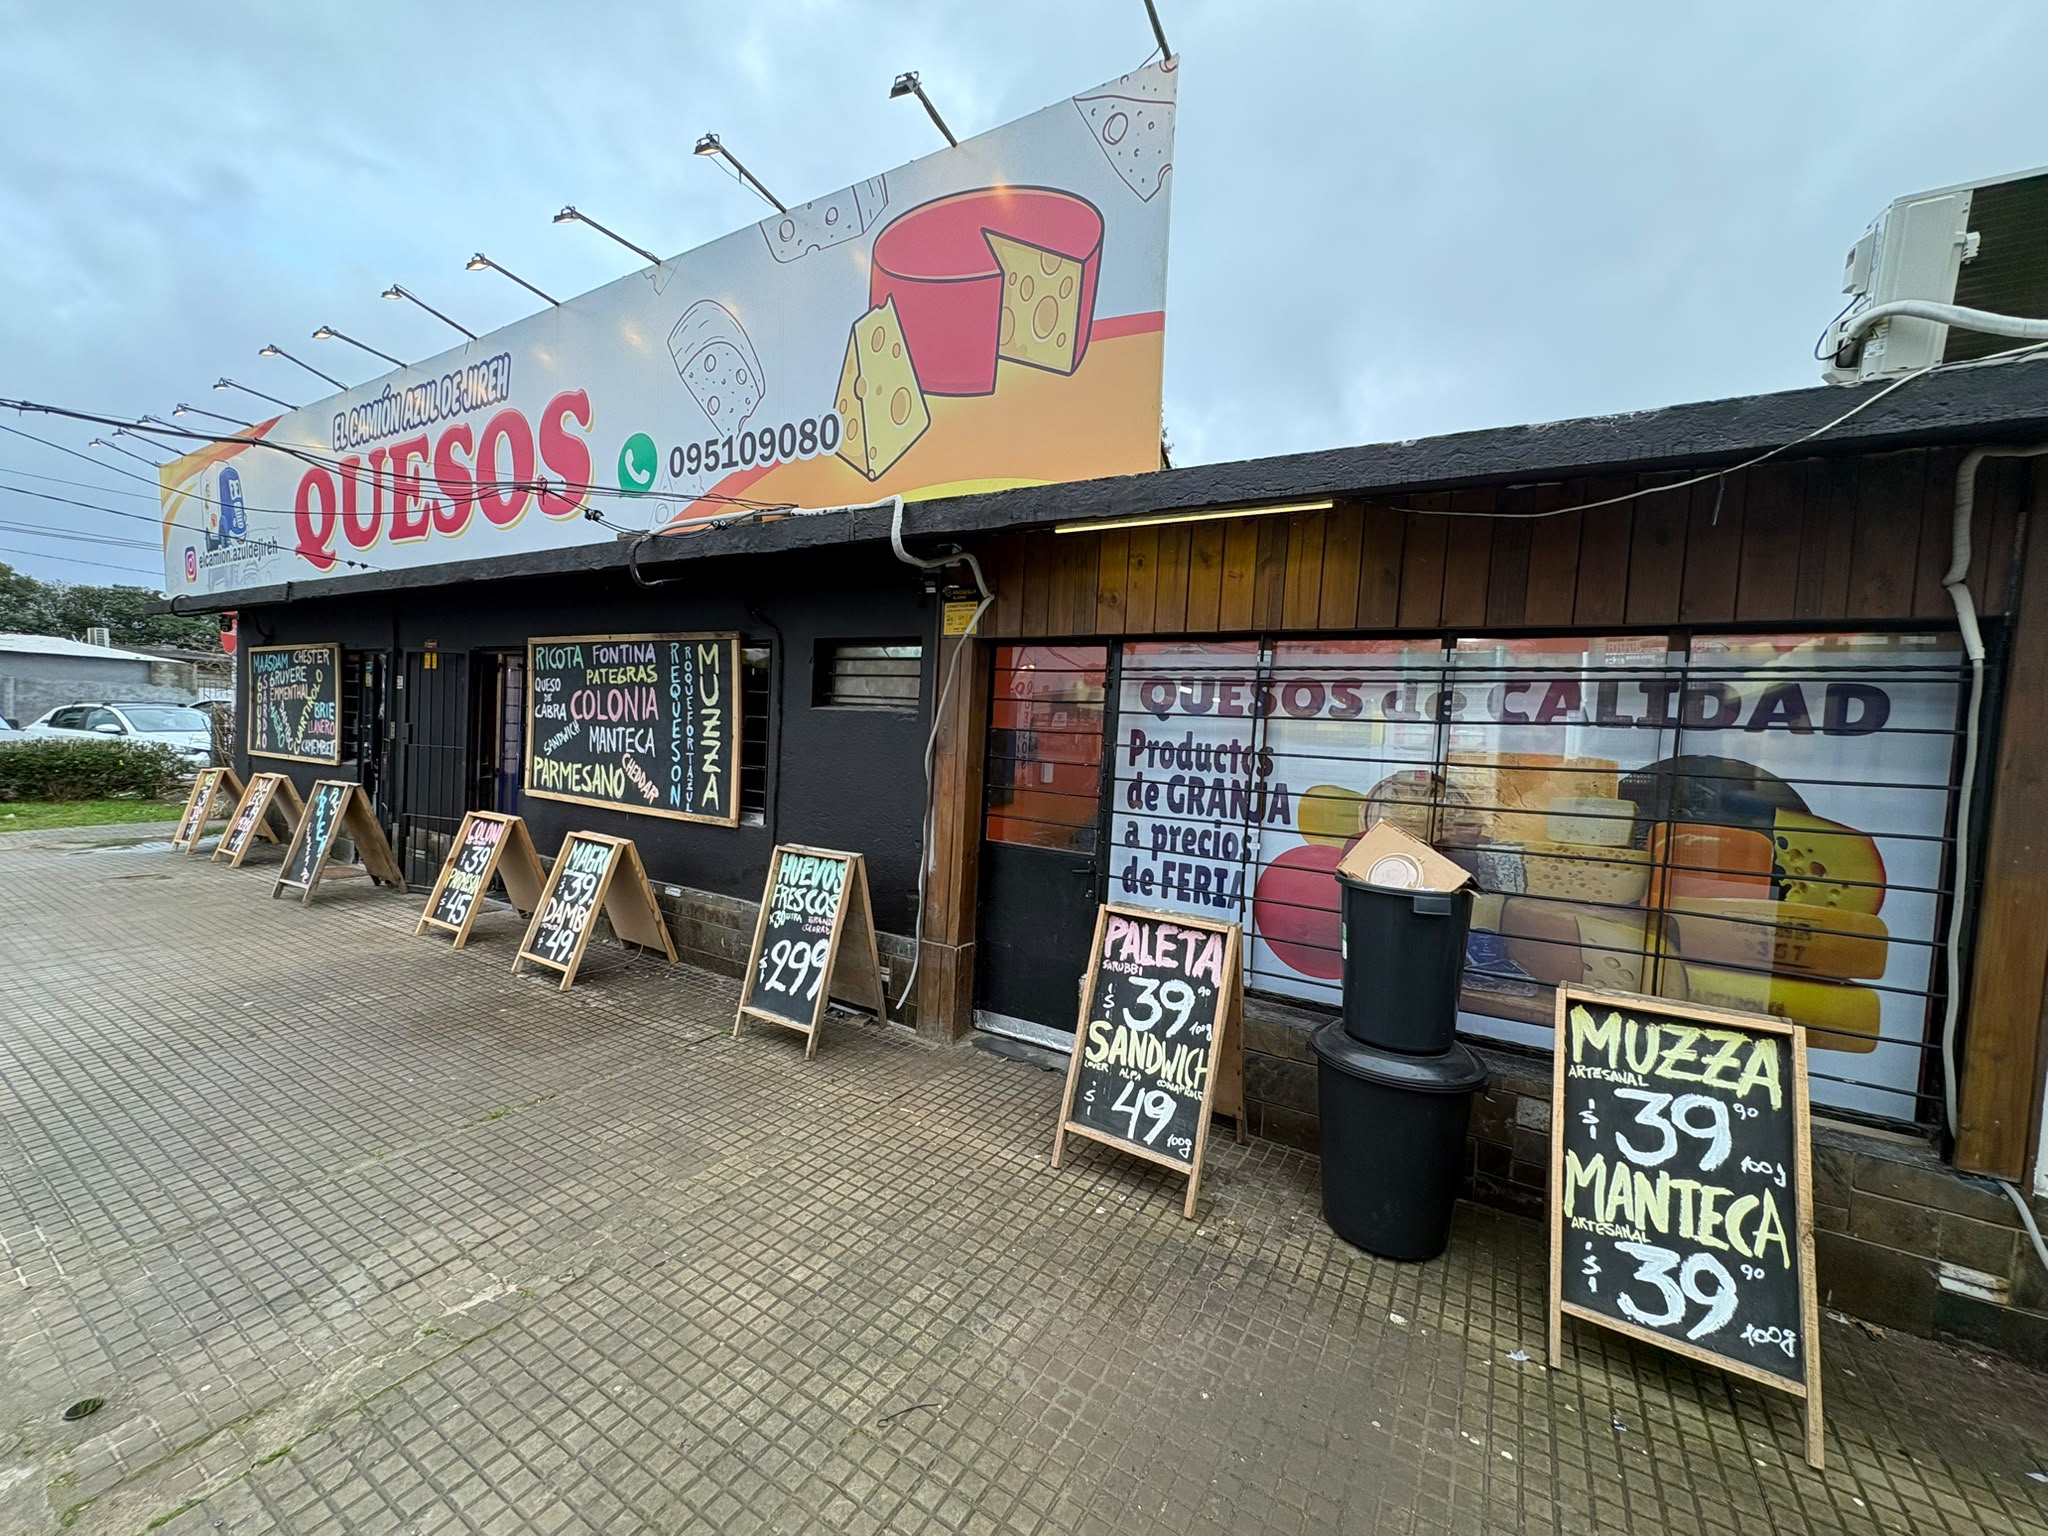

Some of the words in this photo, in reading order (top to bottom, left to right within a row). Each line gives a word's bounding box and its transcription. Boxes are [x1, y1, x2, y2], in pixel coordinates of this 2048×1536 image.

[332, 411, 348, 452] EL
[349, 383, 403, 448] CAMIÓN
[402, 379, 438, 432] AZUL
[441, 369, 463, 419] DE
[463, 352, 511, 413] JIREH
[669, 413, 840, 479] 095109080
[294, 388, 593, 571] QUESOS
[253, 653, 289, 673] MAASDAM
[293, 649, 330, 666] CHESTER
[535, 645, 584, 671] RICOTA
[592, 643, 656, 665] FONTINA
[535, 677, 561, 692] QUESO
[586, 664, 658, 685] PATEGRAS
[313, 702, 335, 720] BRIE
[534, 703, 567, 721] CABRA
[544, 693, 552, 702] DE
[570, 686, 659, 722] COLONIA
[684, 646, 695, 765] ROQUEFORT
[1140, 676, 1363, 721] QUESOS
[1381, 681, 1467, 722] de
[1487, 680, 1891, 736] CALIDAD
[543, 720, 581, 756] SANDWICH
[589, 725, 656, 757] MANTECA
[669, 642, 681, 808] REQUESON
[697, 643, 721, 810] MUZZA
[1129, 729, 1274, 777] Productos
[533, 755, 625, 799] PARMESANO
[621, 753, 660, 805] CHEDDAR
[1127, 772, 1159, 811] de
[1166, 775, 1291, 825] GRANJA
[464, 846, 490, 874] 39
[1125, 820, 1140, 848] a
[1151, 820, 1253, 862] precios
[563, 872, 597, 905] 39
[778, 854, 846, 892] HUEVOS
[1122, 856, 1155, 896] de
[1161, 860, 1246, 912] FERIA
[446, 890, 472, 924] 45
[771, 884, 839, 918] FRESCOS
[545, 928, 575, 961] 49
[1104, 915, 1223, 988] PALETA
[765, 938, 831, 1001] 299
[1102, 959, 1143, 976] SARUBBI
[1122, 976, 1197, 1038] 39
[1085, 1020, 1209, 1093] SANDWICH
[1568, 1064, 1650, 1088] ARTESANAL
[1570, 1004, 1783, 1111] MUZZA
[1111, 1080, 1178, 1146] 49
[1578, 1098, 1600, 1140] $
[1614, 1087, 1733, 1172] 39
[1733, 1103, 1760, 1120] 90
[1166, 1133, 1193, 1159] 100g
[1563, 1148, 1791, 1270] MANTECA
[1571, 1215, 1652, 1245] ARTESANAL
[1580, 1242, 1602, 1293] $
[1614, 1240, 1739, 1341] 39
[1740, 1264, 1766, 1281] 90
